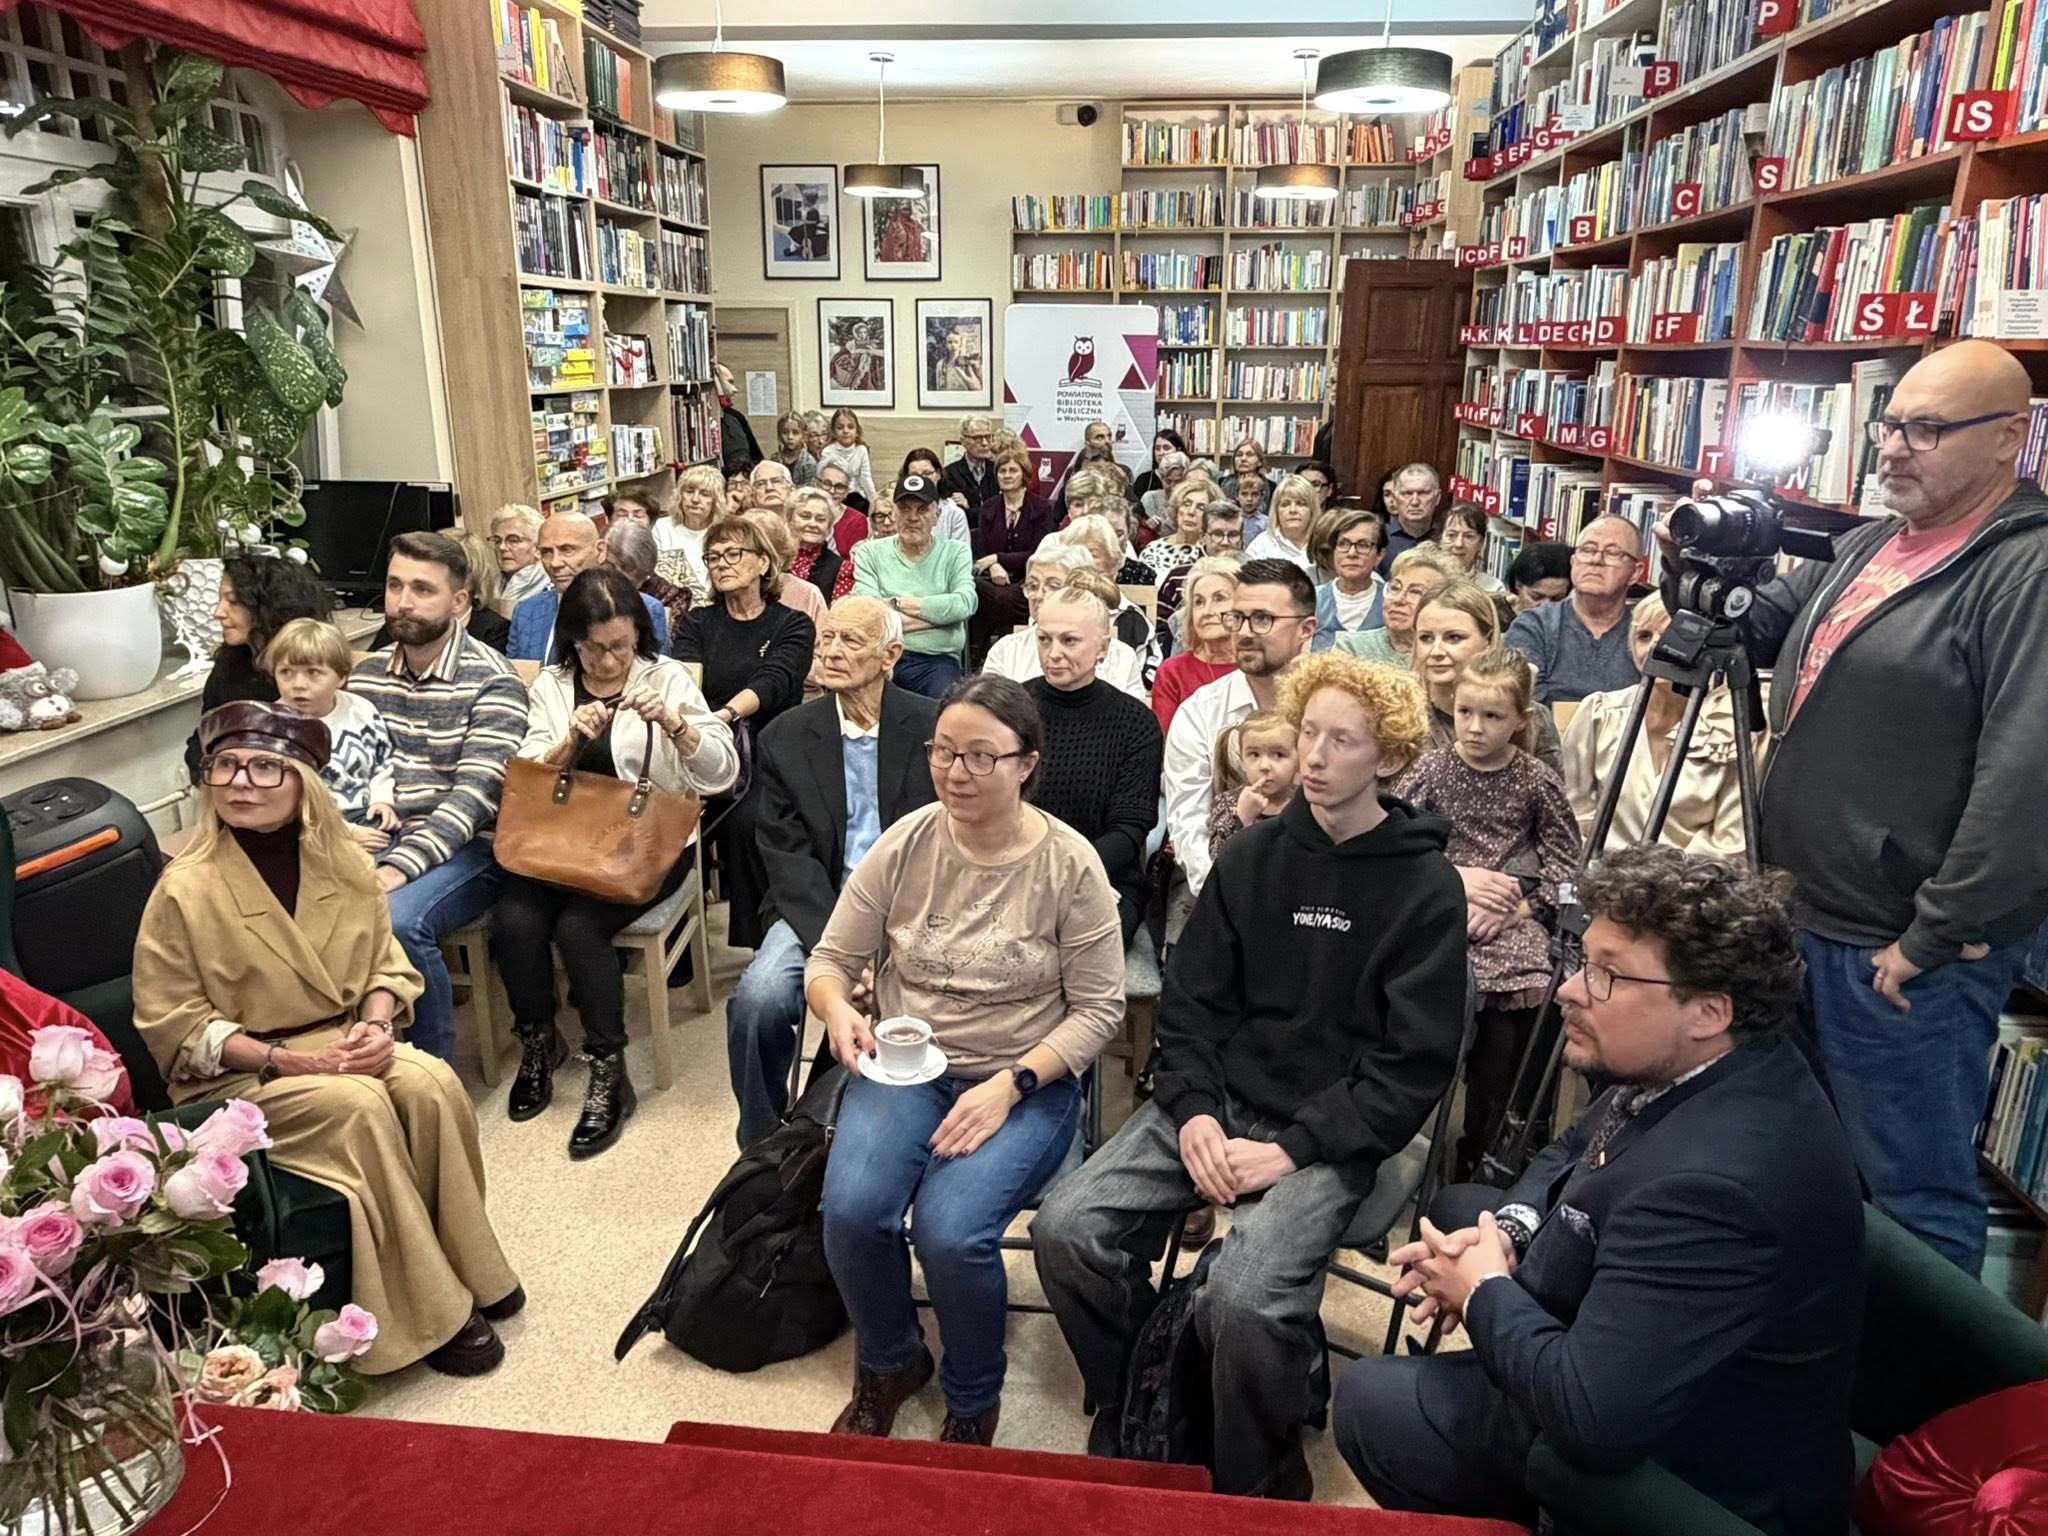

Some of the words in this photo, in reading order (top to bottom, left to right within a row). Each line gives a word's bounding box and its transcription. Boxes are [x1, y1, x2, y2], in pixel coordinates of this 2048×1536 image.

[1758, 1, 1779, 26] P
[1655, 66, 1671, 86] B
[1967, 100, 1993, 132] S
[1536, 131, 1549, 146] G
[1509, 147, 1518, 162] E
[1520, 143, 1530, 157] F
[1494, 153, 1503, 166] S
[1758, 164, 1778, 189] S
[1677, 189, 1694, 210] C
[1576, 220, 1591, 238] B
[1465, 250, 1477, 263] C
[1478, 250, 1488, 261] D
[1489, 245, 1499, 258] F
[1510, 241, 1521, 256] H
[1860, 296, 1886, 332] Ś
[1905, 300, 1929, 329] Ł
[1461, 328, 1472, 341] H
[1518, 327, 1530, 342] L
[1538, 326, 1551, 342] D
[1552, 326, 1564, 342] E
[1598, 321, 1614, 339] D
[1666, 316, 1682, 337] F
[1477, 328, 1488, 342] K
[1490, 411, 1502, 425] M
[1520, 418, 1534, 434] K
[1561, 427, 1577, 443] M
[1590, 430, 1607, 448] G
[1706, 452, 1724, 473] T
[1472, 489, 1485, 502] N
[1485, 496, 1497, 510] P
